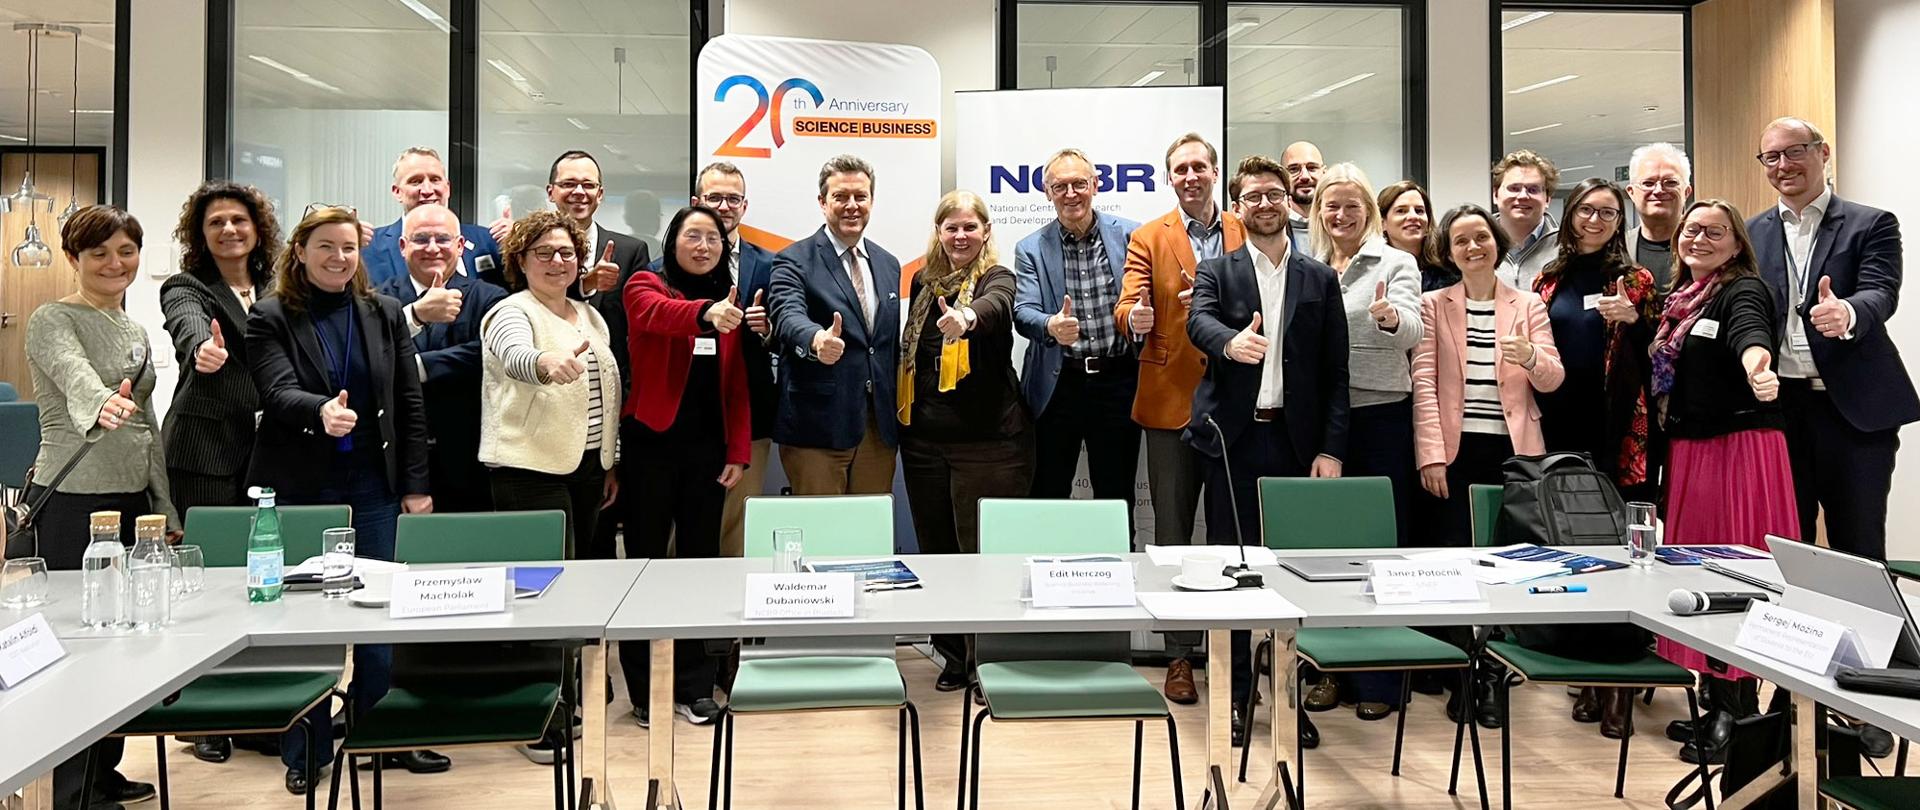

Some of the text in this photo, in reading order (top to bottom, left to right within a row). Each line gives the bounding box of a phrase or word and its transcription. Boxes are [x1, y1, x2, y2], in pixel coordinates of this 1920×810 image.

[829, 98, 909, 115] Anniversary
[990, 203, 1121, 212] National Centr earch
[1010, 216, 1056, 225] Developm
[1050, 570, 1112, 580] Edit Herczog
[773, 583, 828, 591] Waldemar
[420, 590, 475, 600] Macholak
[766, 597, 834, 605] Dubaniowski
[1762, 612, 1791, 629] Sergej
